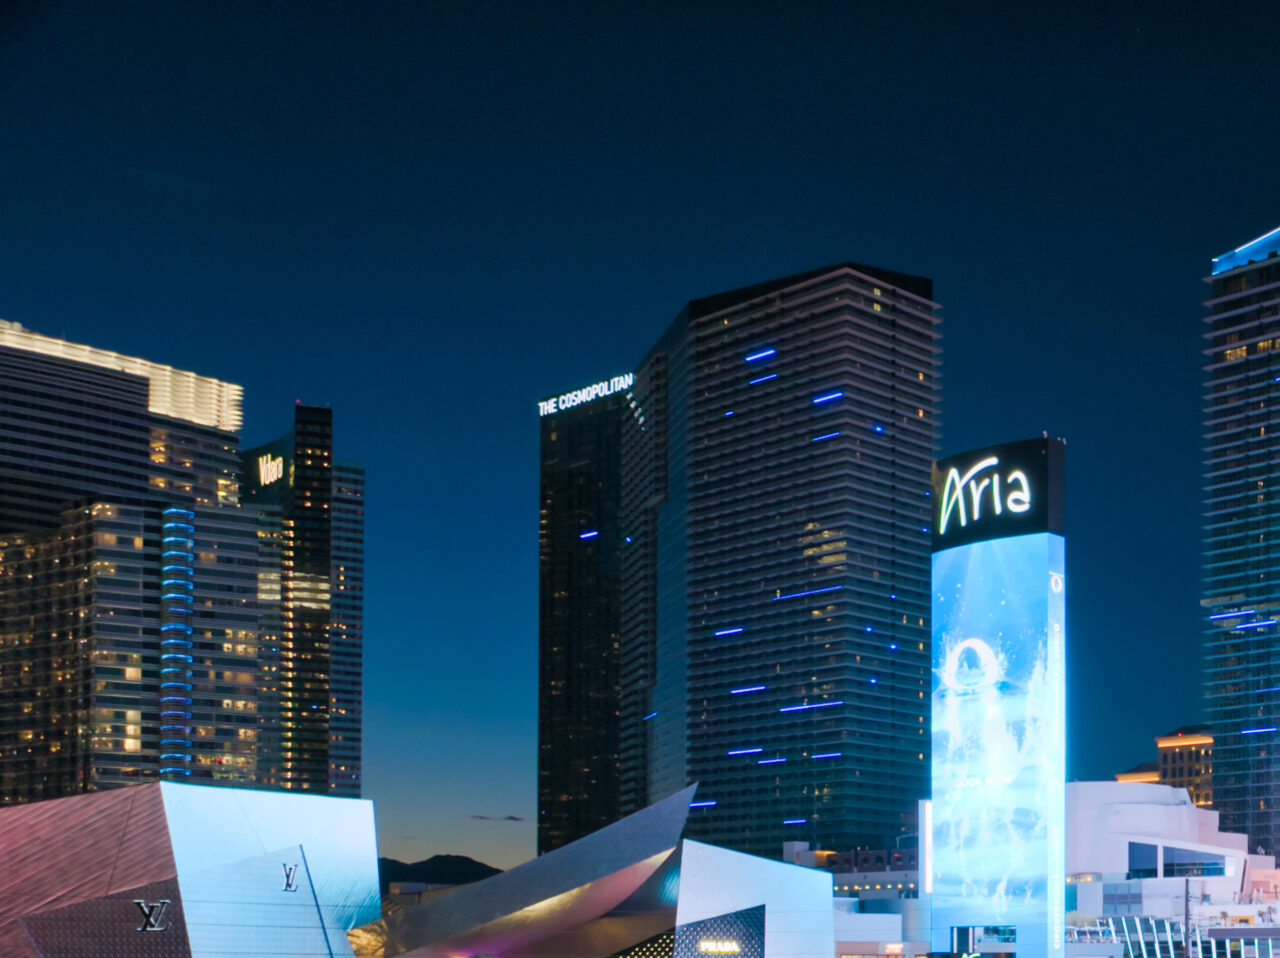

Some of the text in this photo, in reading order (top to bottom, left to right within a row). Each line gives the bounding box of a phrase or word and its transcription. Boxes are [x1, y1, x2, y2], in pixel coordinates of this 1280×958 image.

[538, 372, 634, 416] THE COSMOPOLITAN
[939, 455, 1032, 535] Aria
[699, 941, 740, 953] PRADA
